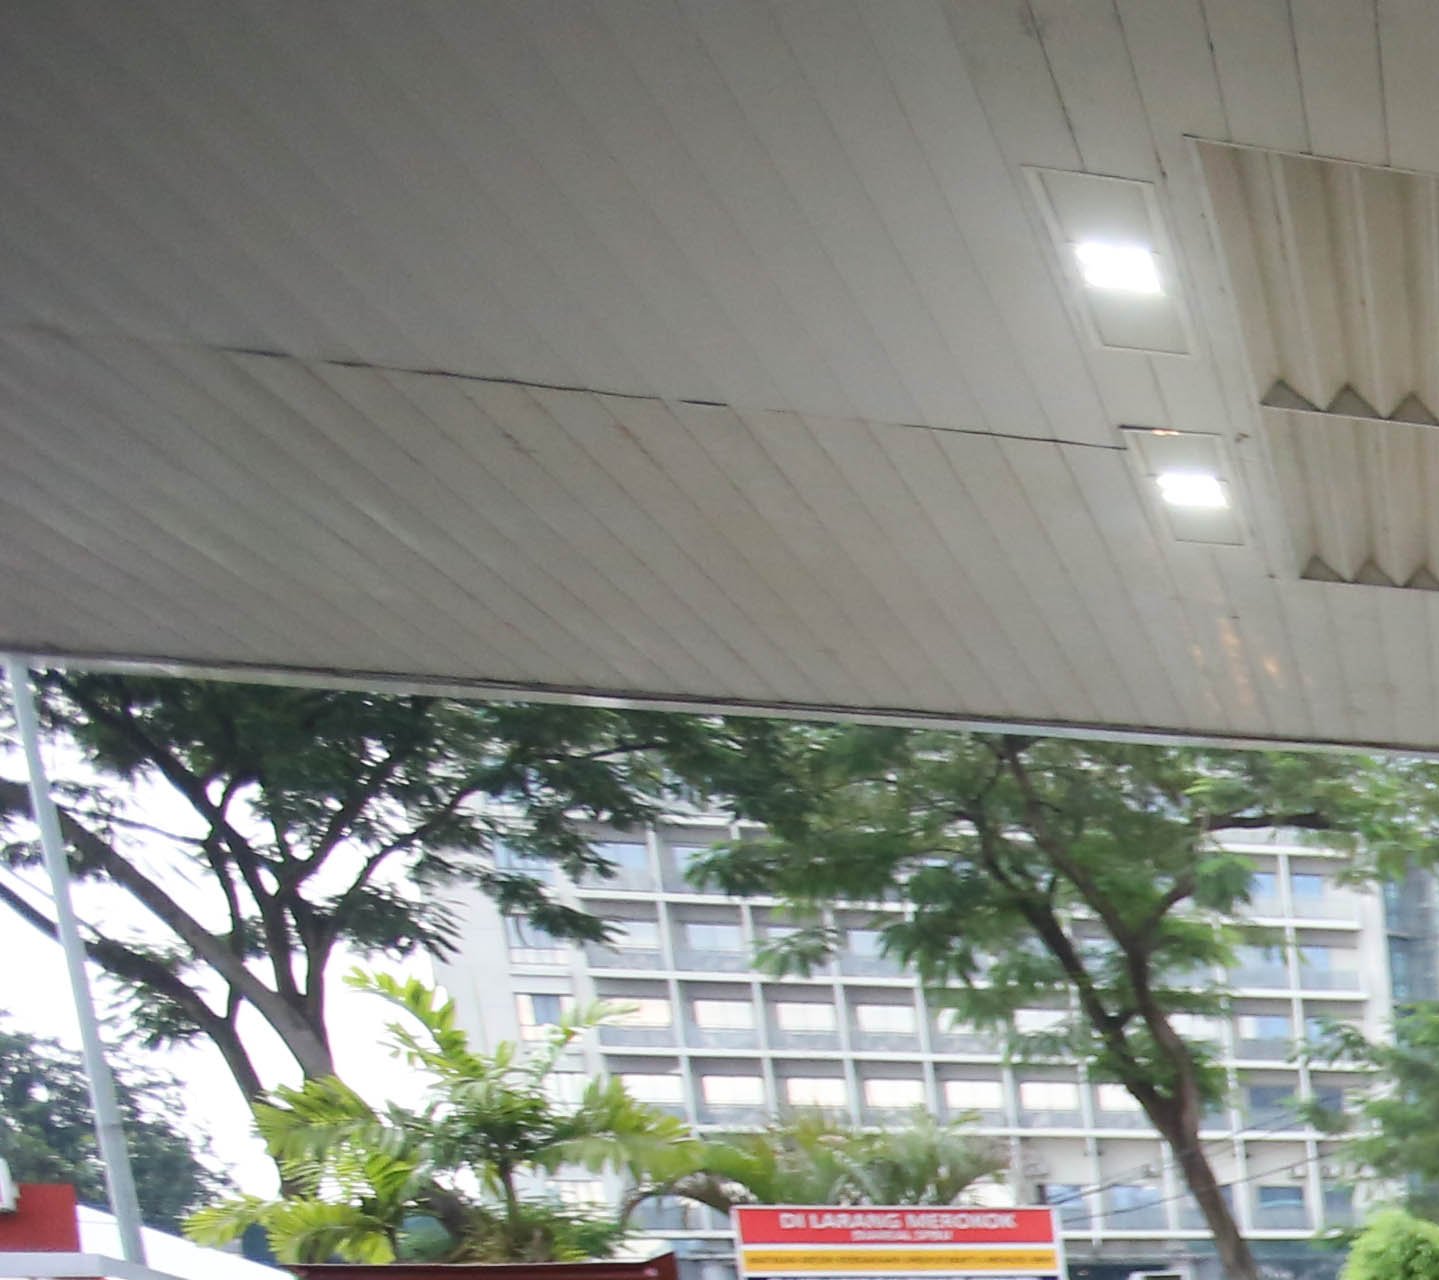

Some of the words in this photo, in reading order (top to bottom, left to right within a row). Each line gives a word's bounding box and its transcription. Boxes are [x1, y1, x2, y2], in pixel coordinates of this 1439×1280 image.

[779, 1213, 805, 1229] DI
[809, 1213, 901, 1229] LARANG
[905, 1213, 1017, 1228] MEROKOK
